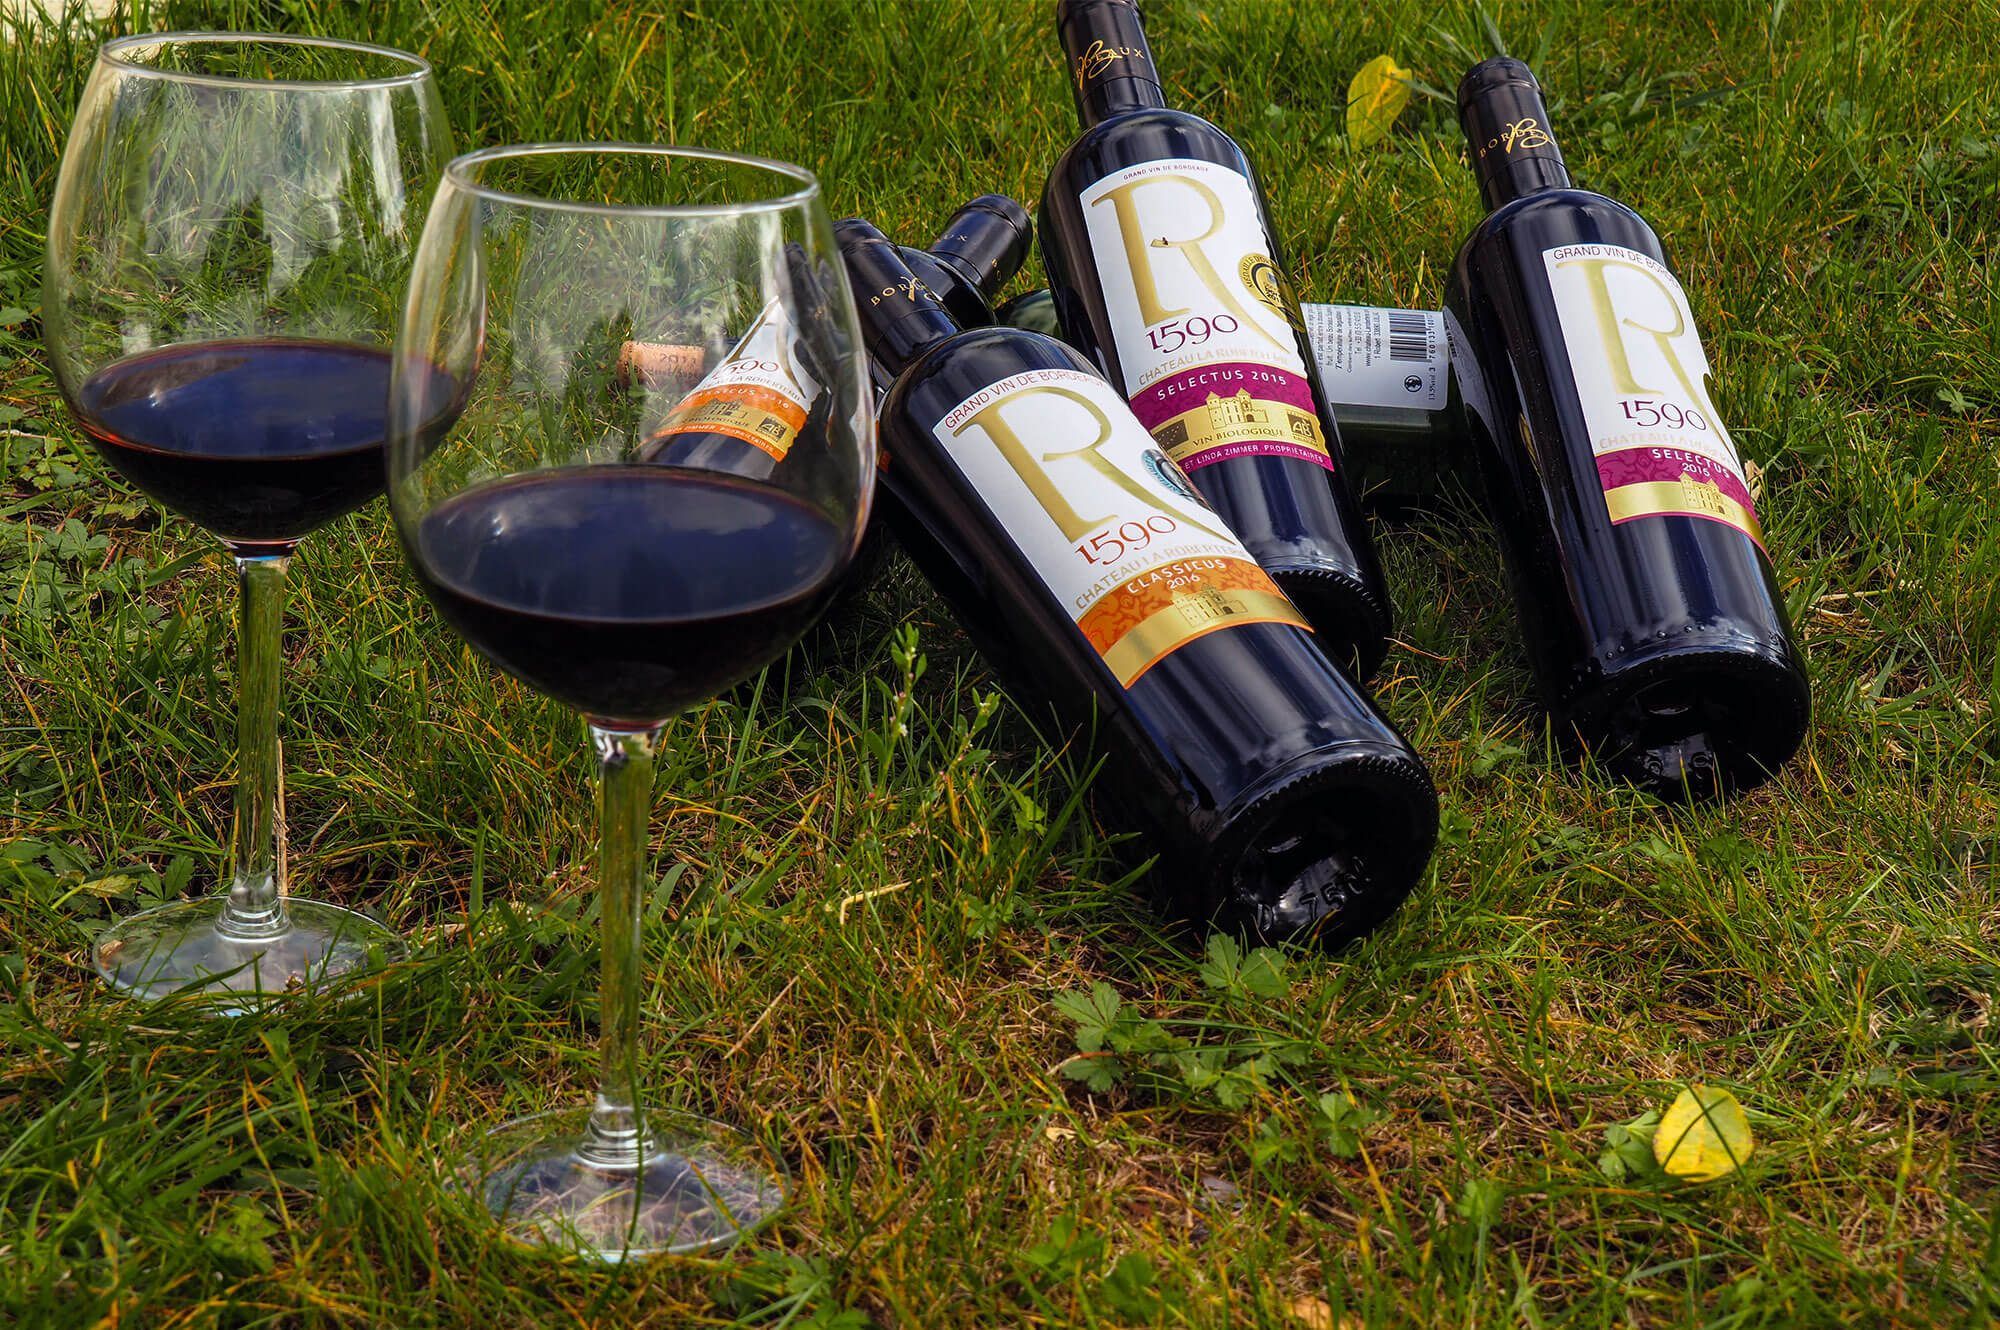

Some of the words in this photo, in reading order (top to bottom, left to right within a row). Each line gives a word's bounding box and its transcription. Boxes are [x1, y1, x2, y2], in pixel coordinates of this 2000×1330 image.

[1123, 168, 1147, 180] GRAND
[1149, 166, 1161, 174] VIN
[1553, 245, 1601, 260] GRAND
[1603, 247, 1625, 259] VIN
[1627, 250, 1643, 264] DE
[1145, 314, 1239, 354] 1590
[1138, 355, 1194, 386] CHATEAU
[1157, 369, 1244, 400] SELECTUS
[1251, 371, 1287, 386] 2015
[945, 391, 990, 430] GRAND
[990, 379, 1016, 396] VIN
[1017, 373, 1039, 387] DE
[1617, 400, 1707, 430] 1590
[1193, 435, 1213, 447] VIN
[952, 386, 1236, 546] R
[1197, 450, 1222, 465] LINDA
[1652, 448, 1730, 479] SELECTUS
[1075, 515, 1176, 566] 1590
[1075, 560, 1142, 609] CHATEAU
[1127, 558, 1227, 594] CLASSICUS
[1166, 572, 1201, 590] 2016
